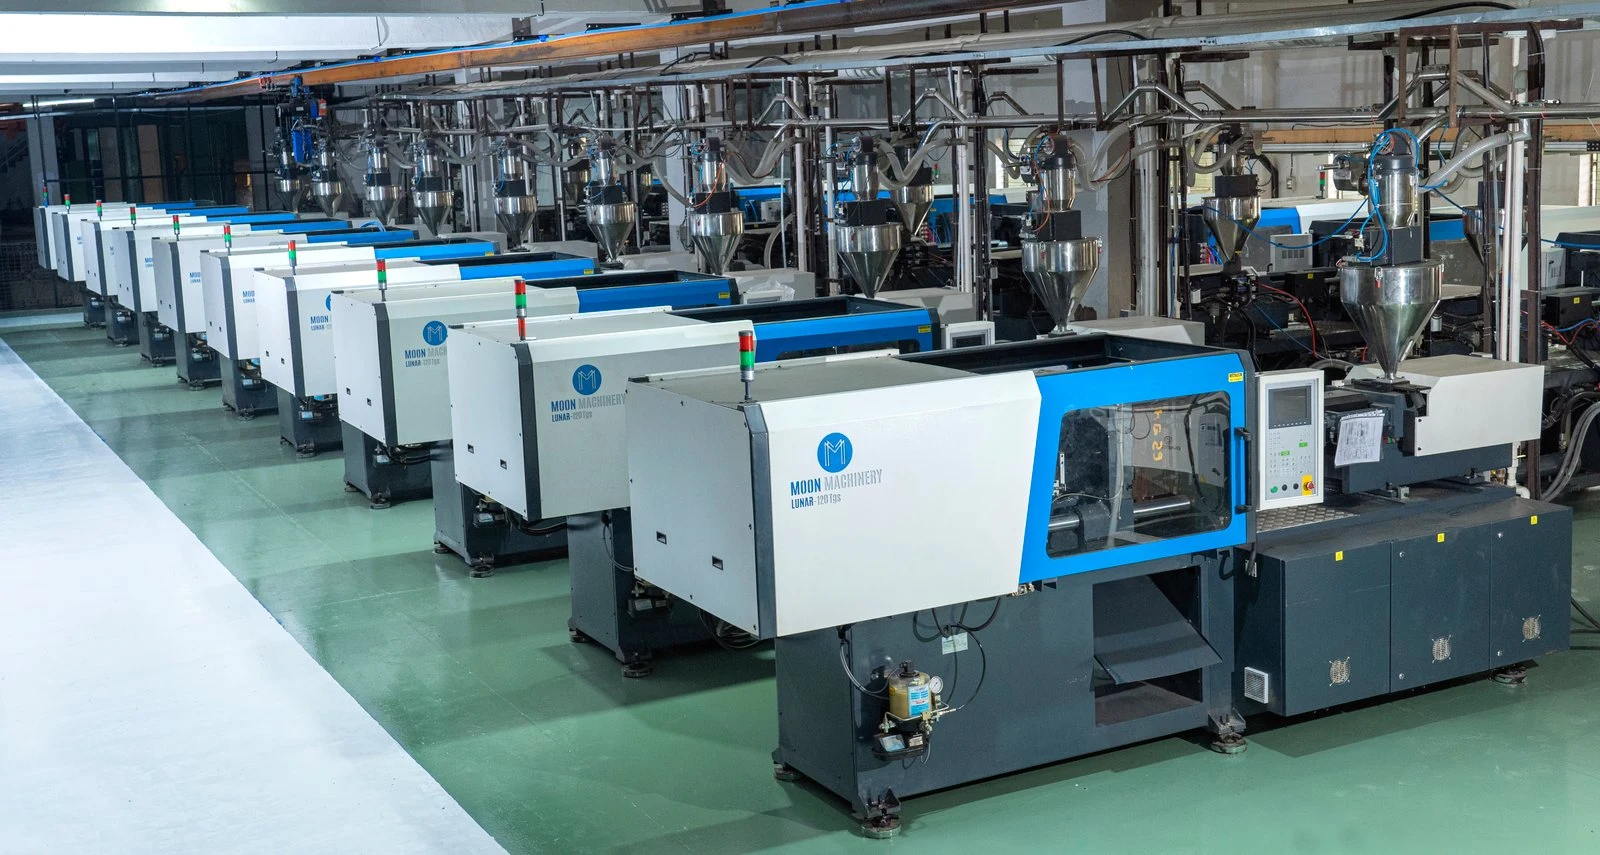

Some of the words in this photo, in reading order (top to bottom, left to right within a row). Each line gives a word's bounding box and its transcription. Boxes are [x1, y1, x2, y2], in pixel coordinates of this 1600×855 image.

[310, 315, 329, 324] MOON
[404, 348, 426, 359] MOON
[551, 399, 576, 412] MOON
[578, 393, 626, 410] MACHINERY
[790, 478, 821, 496] MOON
[824, 469, 883, 491] MACHINERY
